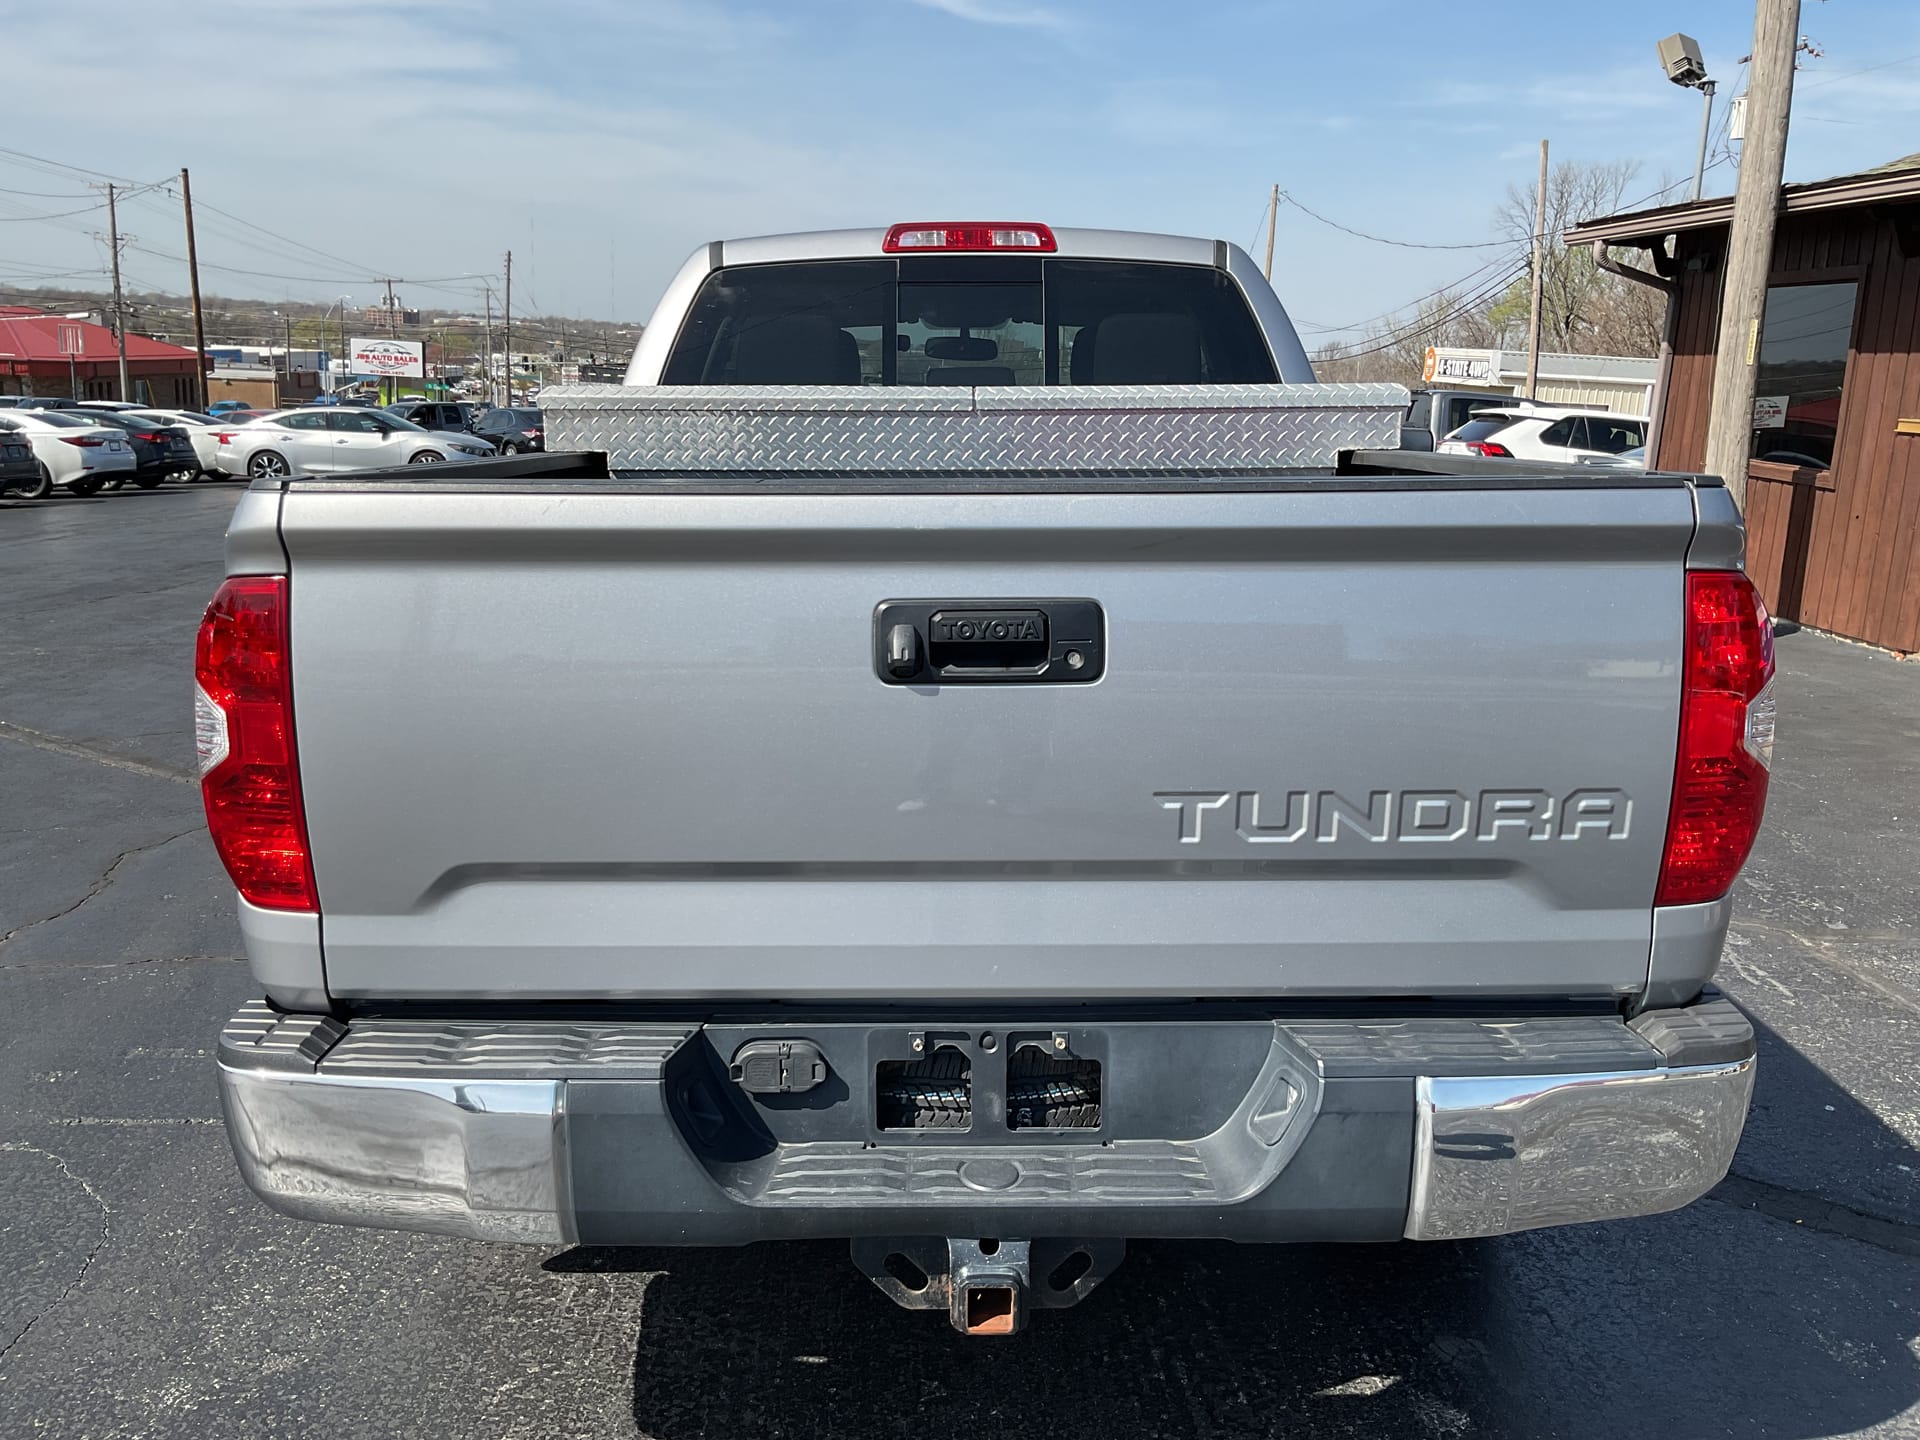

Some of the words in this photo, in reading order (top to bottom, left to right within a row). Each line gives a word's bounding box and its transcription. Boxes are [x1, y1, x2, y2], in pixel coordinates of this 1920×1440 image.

[393, 355, 419, 363] SALES
[1439, 359, 1469, 377] 4-STATE
[1469, 361, 1489, 378] 4WD
[941, 619, 1040, 640] TOYOTA
[1153, 787, 1633, 843] TUNDRA
